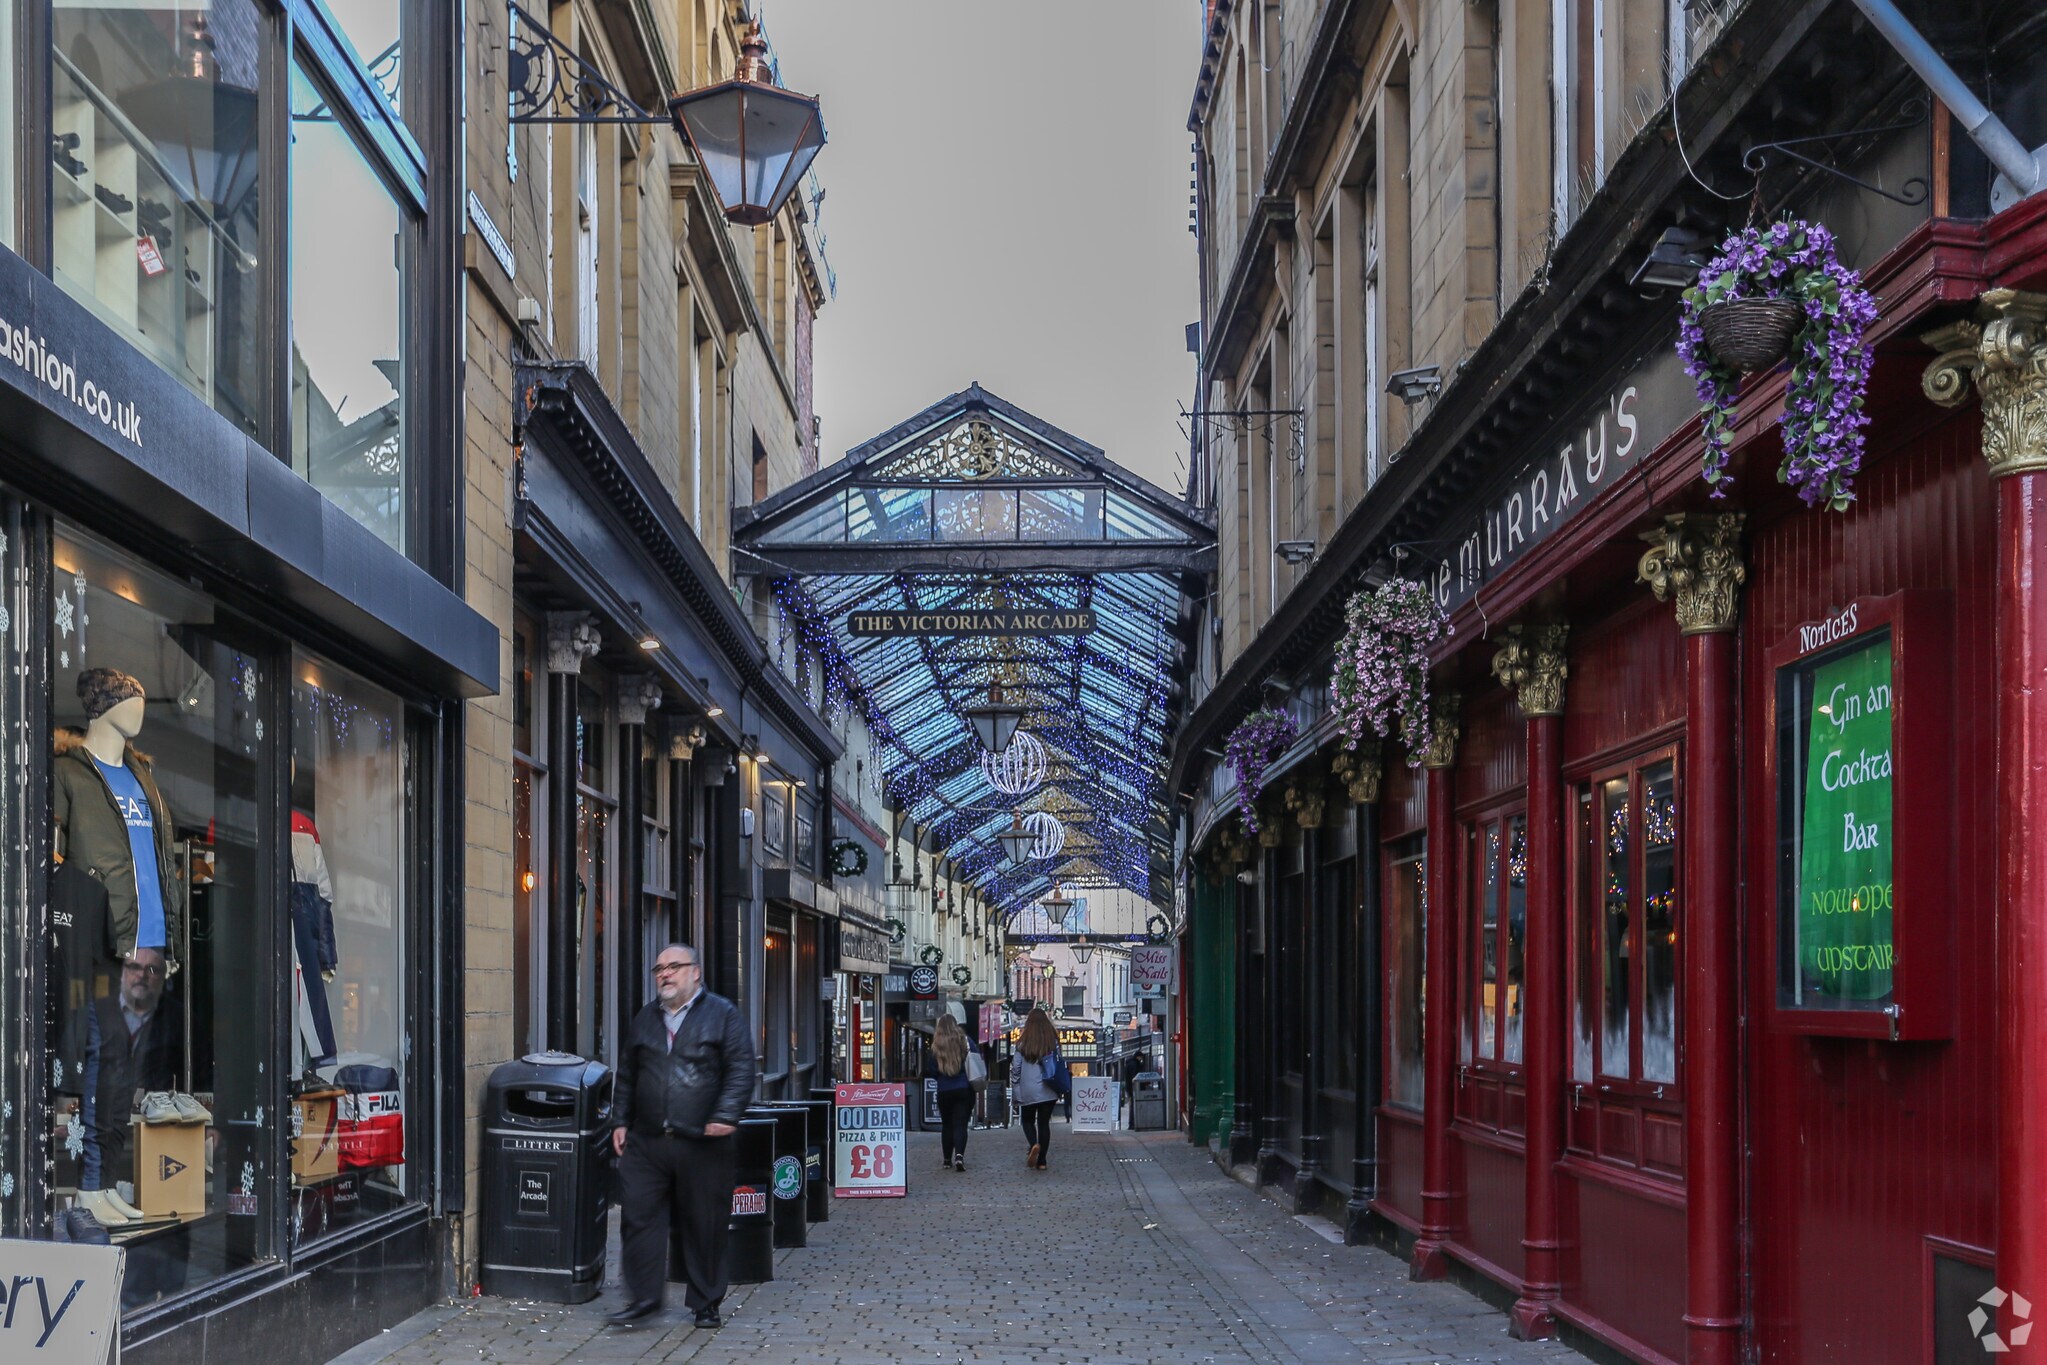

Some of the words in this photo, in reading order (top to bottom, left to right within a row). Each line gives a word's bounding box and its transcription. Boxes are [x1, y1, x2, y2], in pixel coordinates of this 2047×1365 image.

[855, 617, 893, 631] THE
[899, 615, 1005, 631] VICTORIAN
[1010, 614, 1090, 630] ARCADE
[1800, 602, 1858, 654] NOTICES
[1829, 683, 1860, 735] Gin
[1866, 683, 1892, 714] an
[53, 910, 73, 923] EA7
[1135, 950, 1167, 964] Miss
[1133, 965, 1168, 980] Nails
[1060, 1030, 1096, 1043] LILY'S
[1077, 1087, 1106, 1099] Miss
[368, 1095, 400, 1112] FILA
[1076, 1101, 1108, 1113] Nails
[871, 1110, 899, 1126] BAR
[839, 1132, 866, 1142] PIZZA
[870, 1131, 877, 1142] &
[881, 1131, 901, 1142] PINT
[515, 1140, 560, 1150] LITTER
[527, 1180, 542, 1189] The
[520, 1191, 548, 1201] Arcade
[0, 1275, 85, 1347] ry
